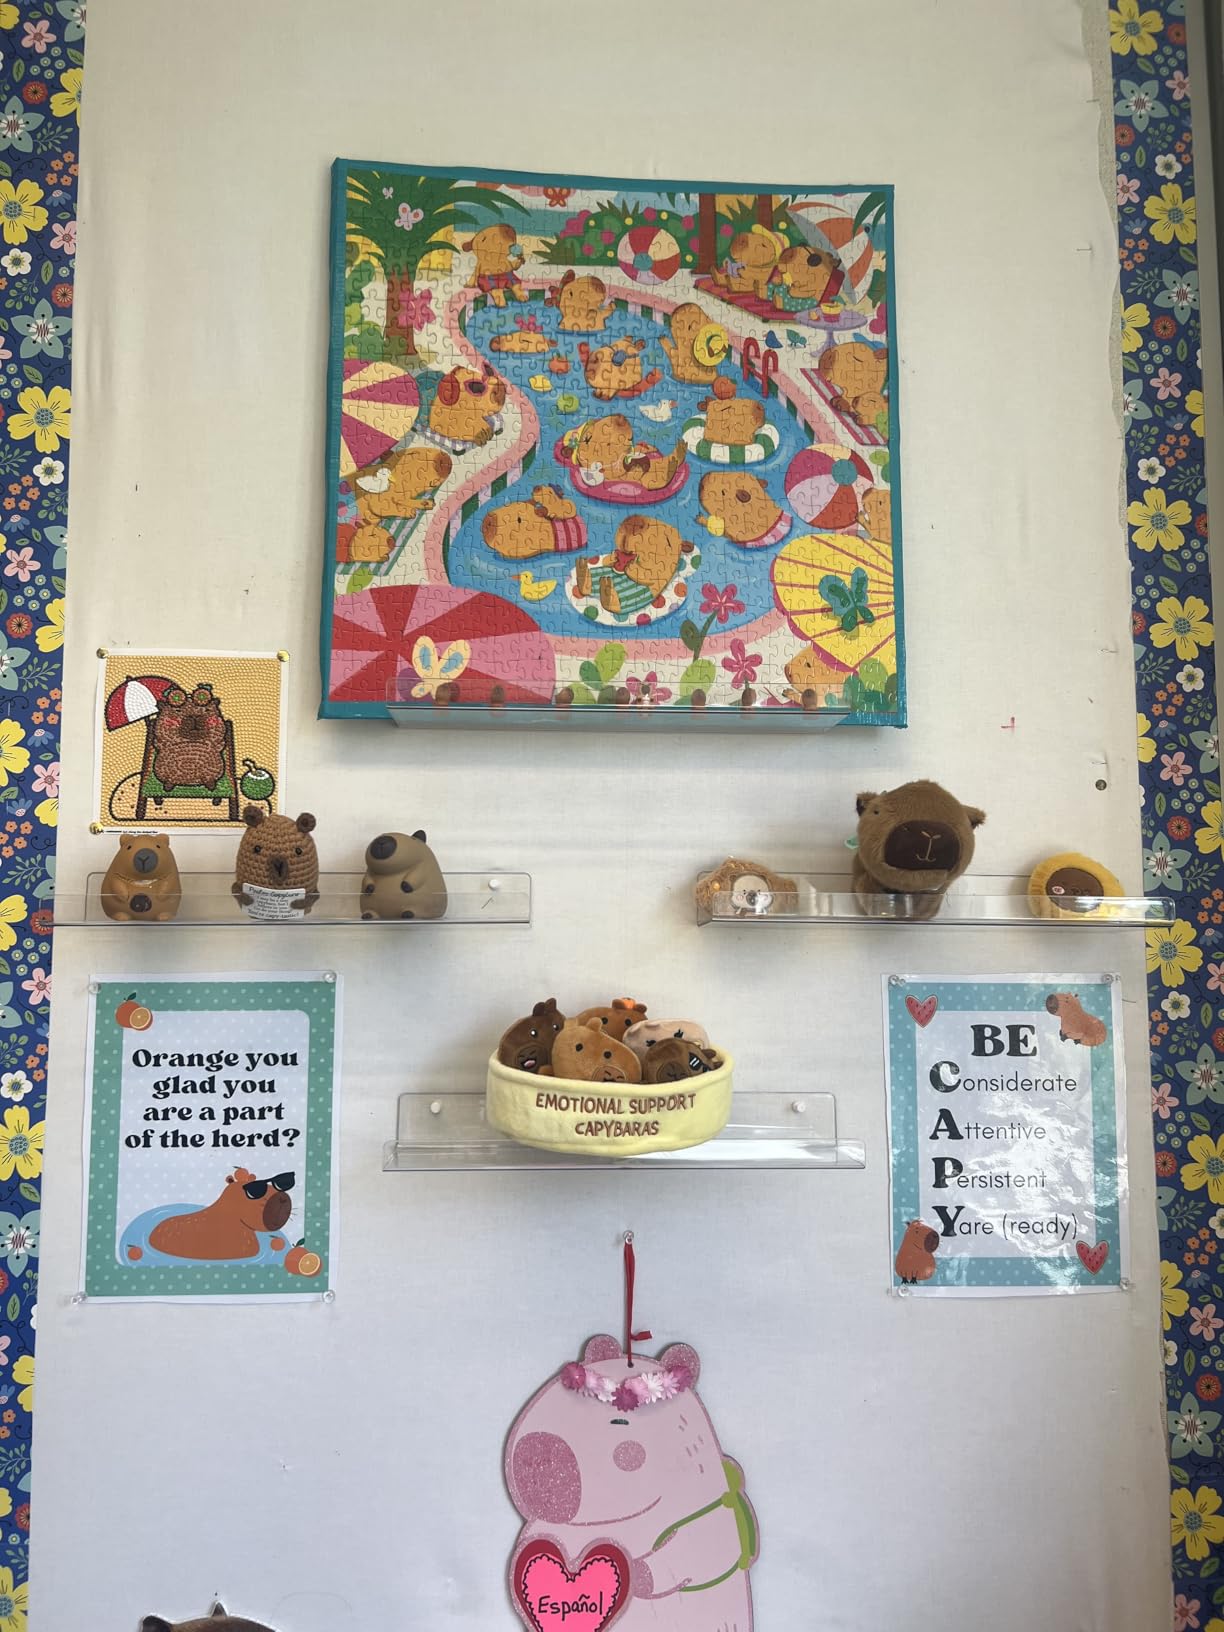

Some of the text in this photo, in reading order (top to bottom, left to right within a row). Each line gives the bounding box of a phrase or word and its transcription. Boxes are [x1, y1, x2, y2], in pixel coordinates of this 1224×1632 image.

[970, 1024, 1038, 1057] BE
[131, 1048, 299, 1072] Orange you
[151, 1075, 276, 1099] glad you
[929, 1060, 1077, 1093] Considerate
[143, 1102, 285, 1125] are a part
[536, 1092, 697, 1115] EMOTIONAL SUPPORT
[575, 1120, 659, 1137] CAPYBARAS
[929, 1108, 1047, 1140] Attentive
[125, 1127, 300, 1149] of the herd?
[931, 1157, 1047, 1189] Persistent
[932, 1205, 1077, 1240] Yare (ready)
[538, 1591, 603, 1621] Español
